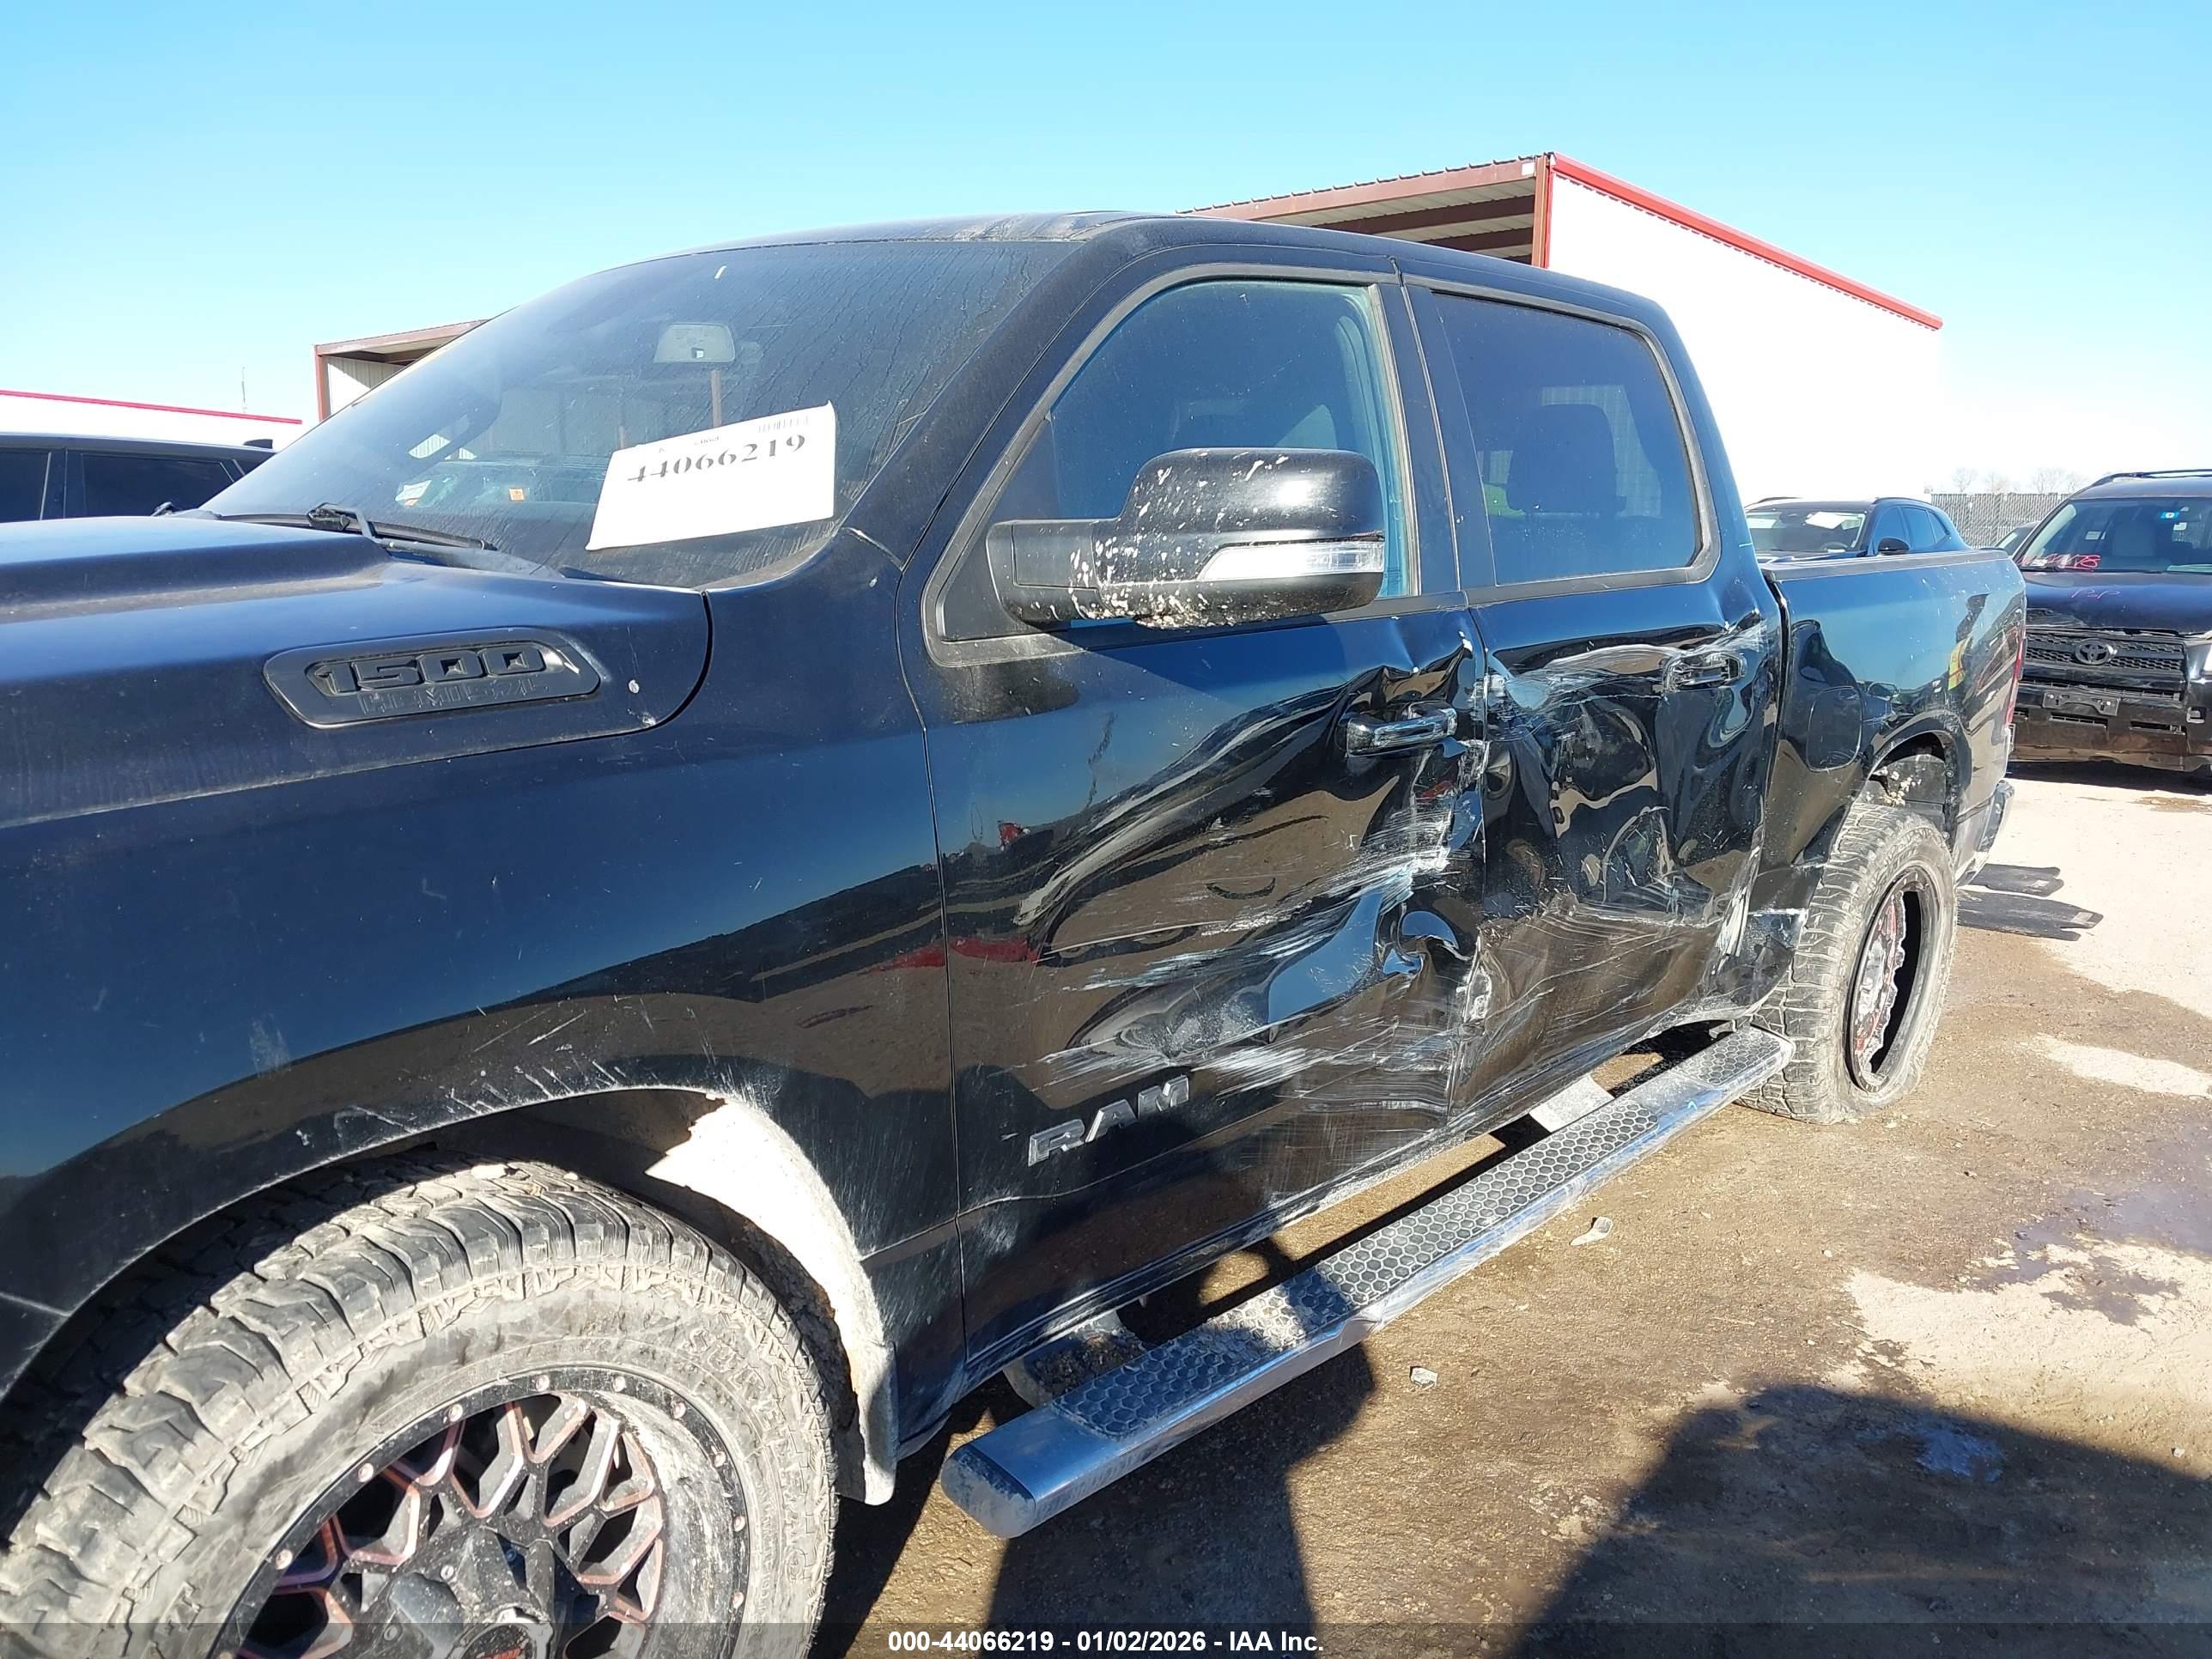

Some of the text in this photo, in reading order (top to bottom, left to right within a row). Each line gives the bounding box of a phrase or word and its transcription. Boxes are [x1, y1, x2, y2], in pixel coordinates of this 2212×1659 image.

[627, 434, 806, 483] 44066219
[314, 647, 546, 694] 1500
[1028, 1074, 1189, 1167] RAM
